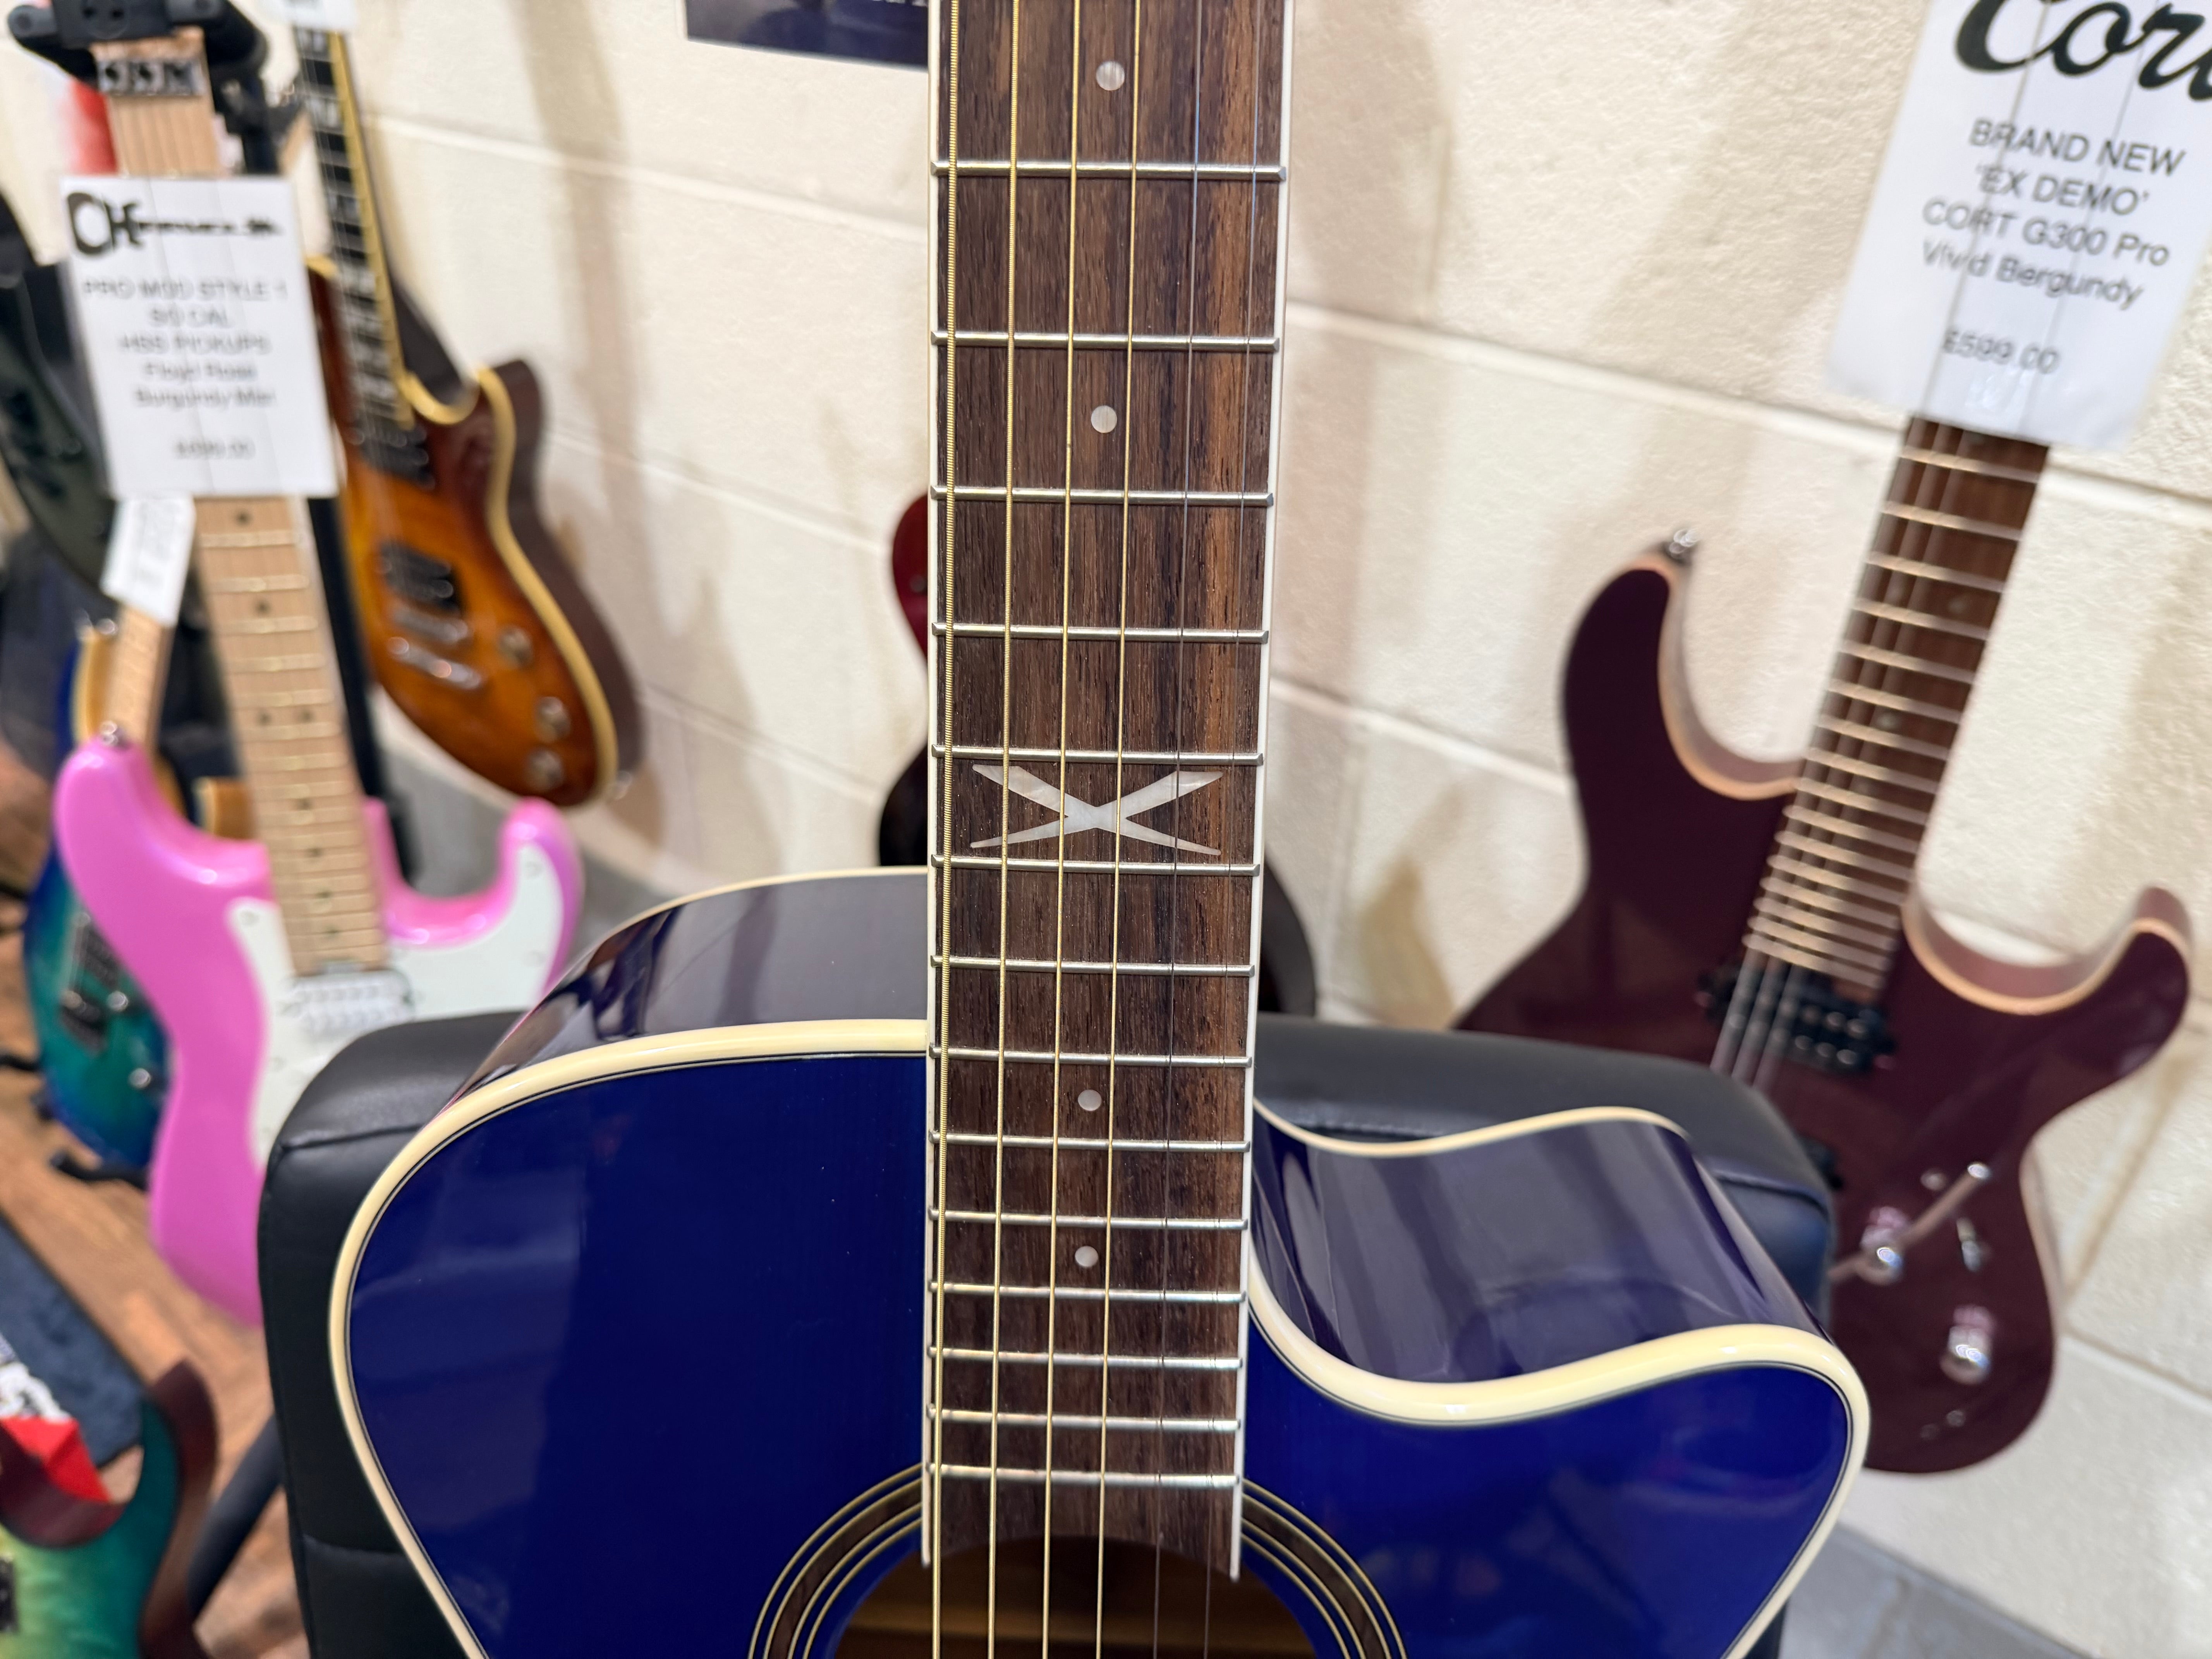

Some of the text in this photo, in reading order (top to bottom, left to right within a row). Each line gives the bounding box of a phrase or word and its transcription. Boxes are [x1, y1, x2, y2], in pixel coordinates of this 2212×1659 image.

[1968, 118, 2185, 176] BRAND NEW
[1922, 198, 2169, 266] CORT G300 Pro
[1922, 240, 2144, 310] Vivid Bergundy
